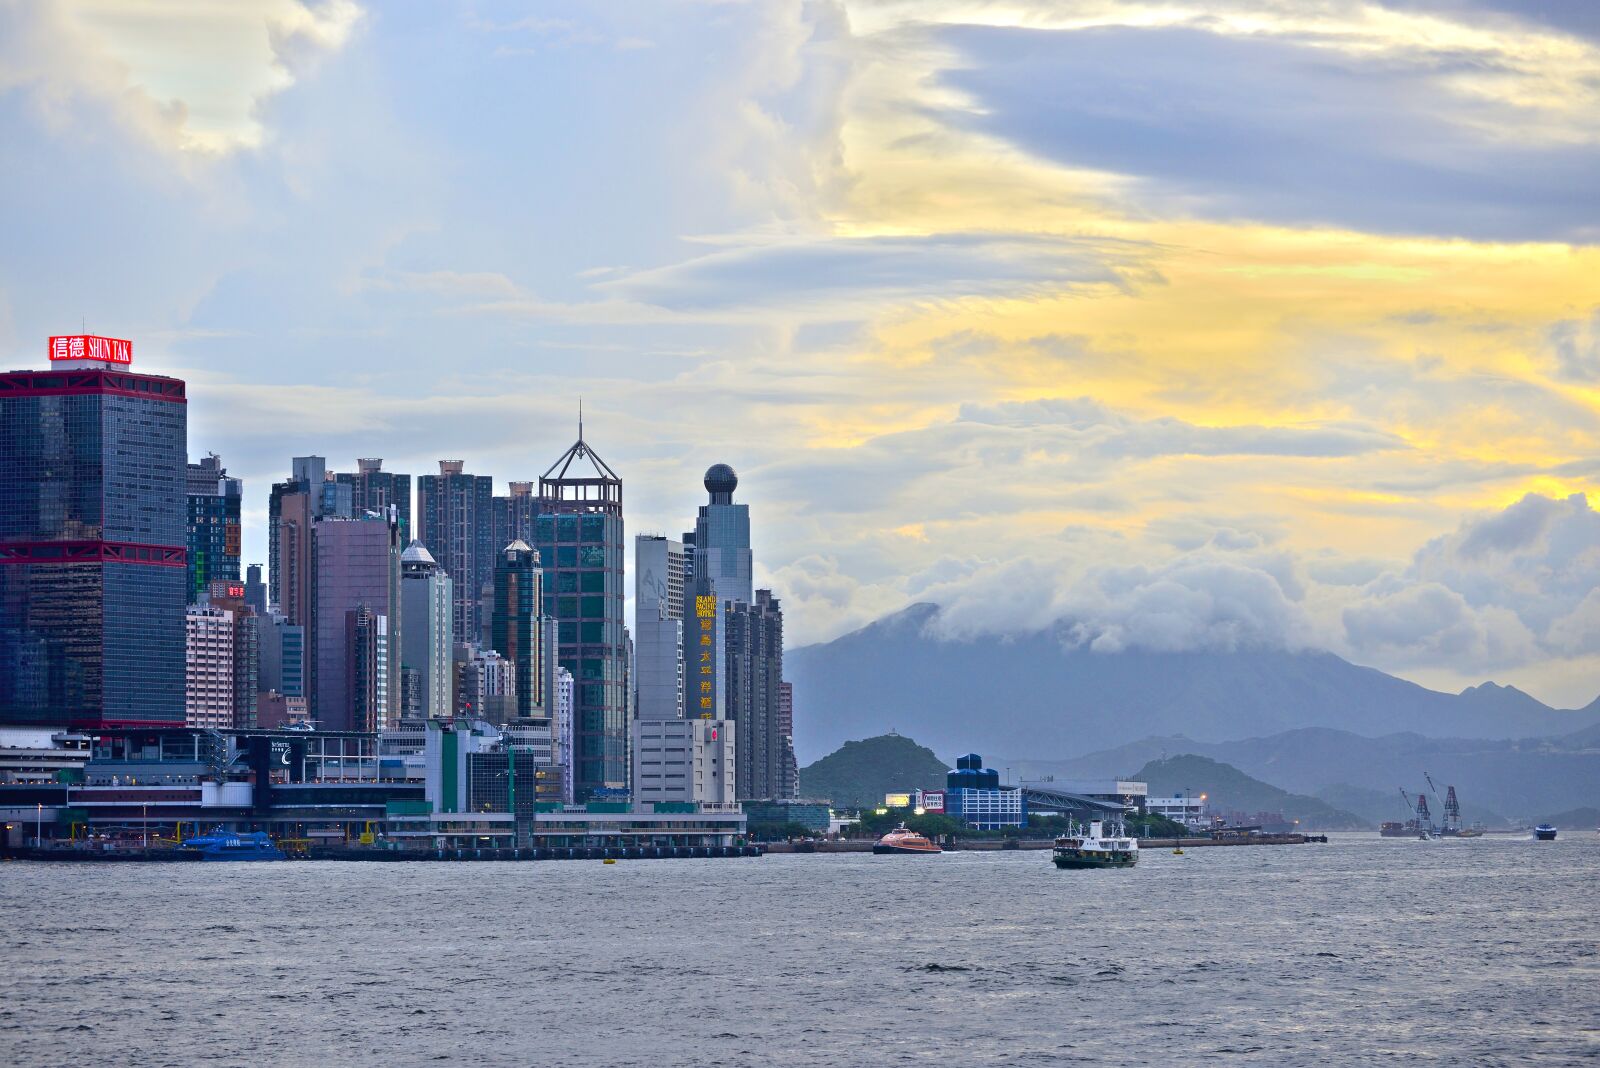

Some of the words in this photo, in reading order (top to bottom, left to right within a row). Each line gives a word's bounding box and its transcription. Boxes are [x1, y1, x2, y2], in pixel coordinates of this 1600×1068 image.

[52, 337, 85, 358] 信德
[88, 337, 111, 359] SHUN
[113, 340, 130, 362] TAK
[696, 595, 716, 603] ISLAND
[695, 602, 716, 610] PACIFIC
[696, 609, 716, 618] HOTEL
